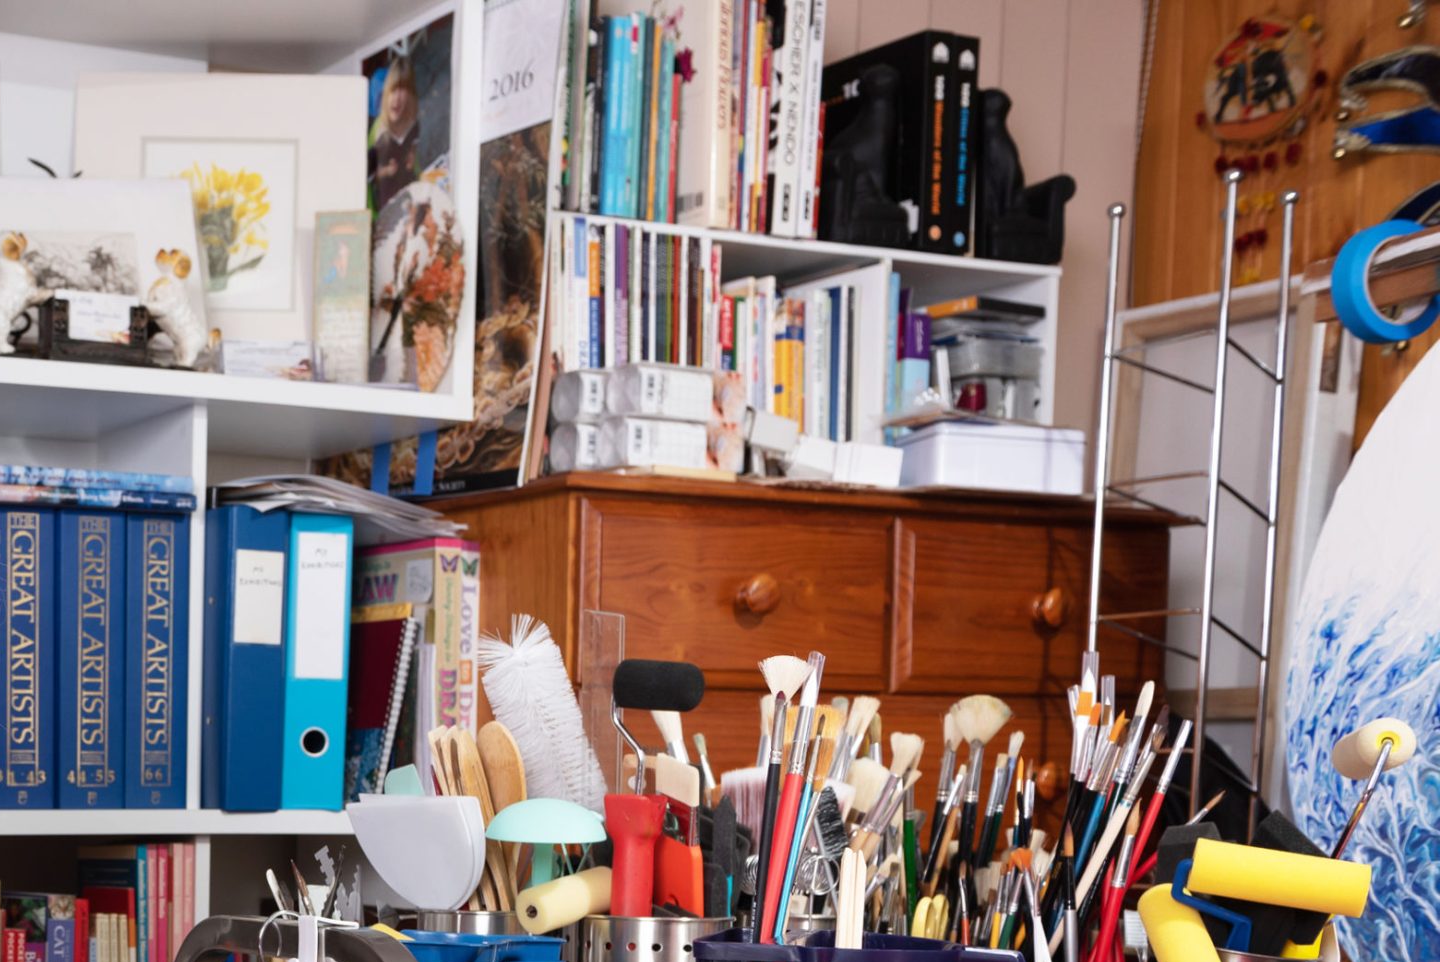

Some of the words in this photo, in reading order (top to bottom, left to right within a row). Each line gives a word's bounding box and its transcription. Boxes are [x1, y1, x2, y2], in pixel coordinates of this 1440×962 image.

[786, 1, 805, 77] ESCHER
[488, 58, 536, 102] 2016
[717, 64, 731, 130] Flowers
[789, 82, 798, 95] X
[934, 74, 945, 100] 100
[960, 82, 971, 107] 100
[784, 101, 797, 166] NENDO
[933, 101, 944, 148] Wonders
[959, 140, 968, 152] of
[932, 163, 942, 180] the
[933, 150, 942, 161] of
[958, 154, 968, 171] the
[931, 183, 941, 216] World
[956, 174, 967, 206] World
[10, 514, 37, 528] THE
[81, 518, 106, 532] THE
[11, 530, 36, 624] GREAT
[82, 535, 106, 627] GREAT
[146, 537, 169, 628] GREAT
[460, 584, 476, 654] Love
[11, 629, 35, 744] ARTISTS
[81, 632, 104, 745] ARTISTS
[145, 633, 168, 745] ARTISTS
[439, 668, 457, 728] DRA
[53, 925, 66, 958] CAT
